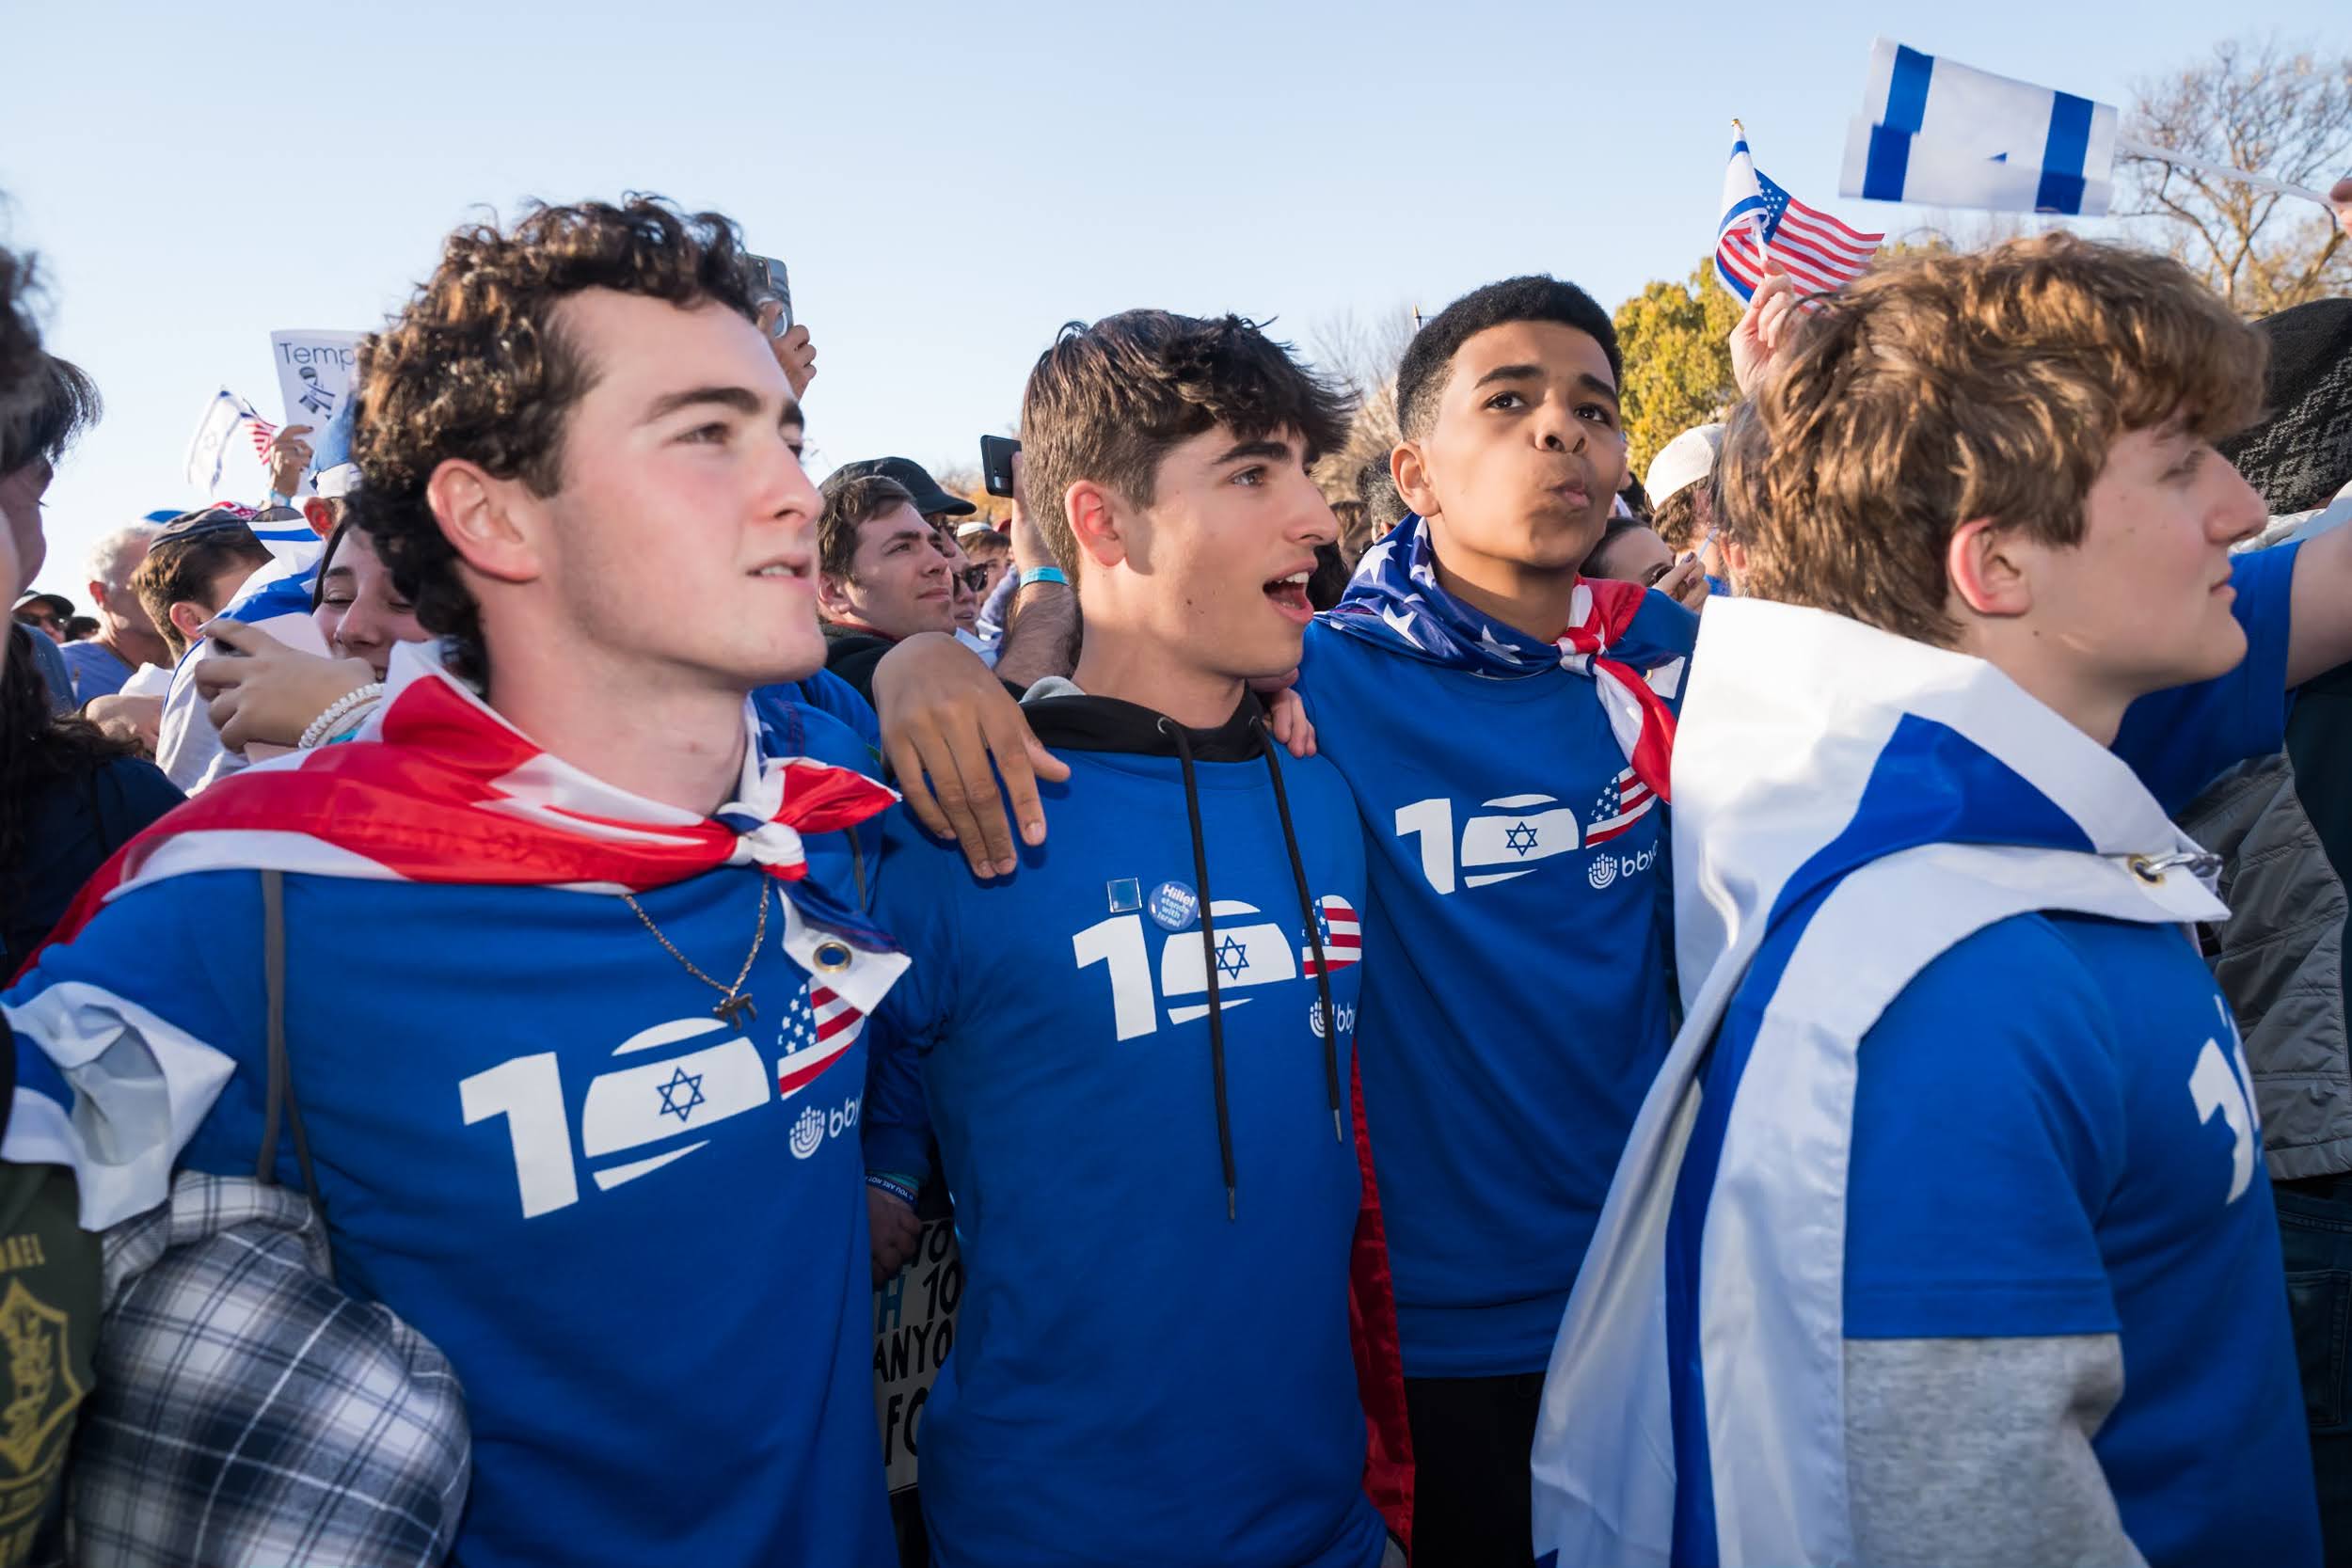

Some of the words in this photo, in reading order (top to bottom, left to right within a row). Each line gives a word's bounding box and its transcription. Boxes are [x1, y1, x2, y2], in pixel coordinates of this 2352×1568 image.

[278, 341, 357, 372] Temp
[1162, 883, 1196, 908] Hillel
[1160, 896, 1190, 914] stands
[1161, 906, 1182, 920] with
[1157, 911, 1182, 927] Israel
[882, 1180, 896, 1190] ARE
[895, 1186, 909, 1197] YOU
